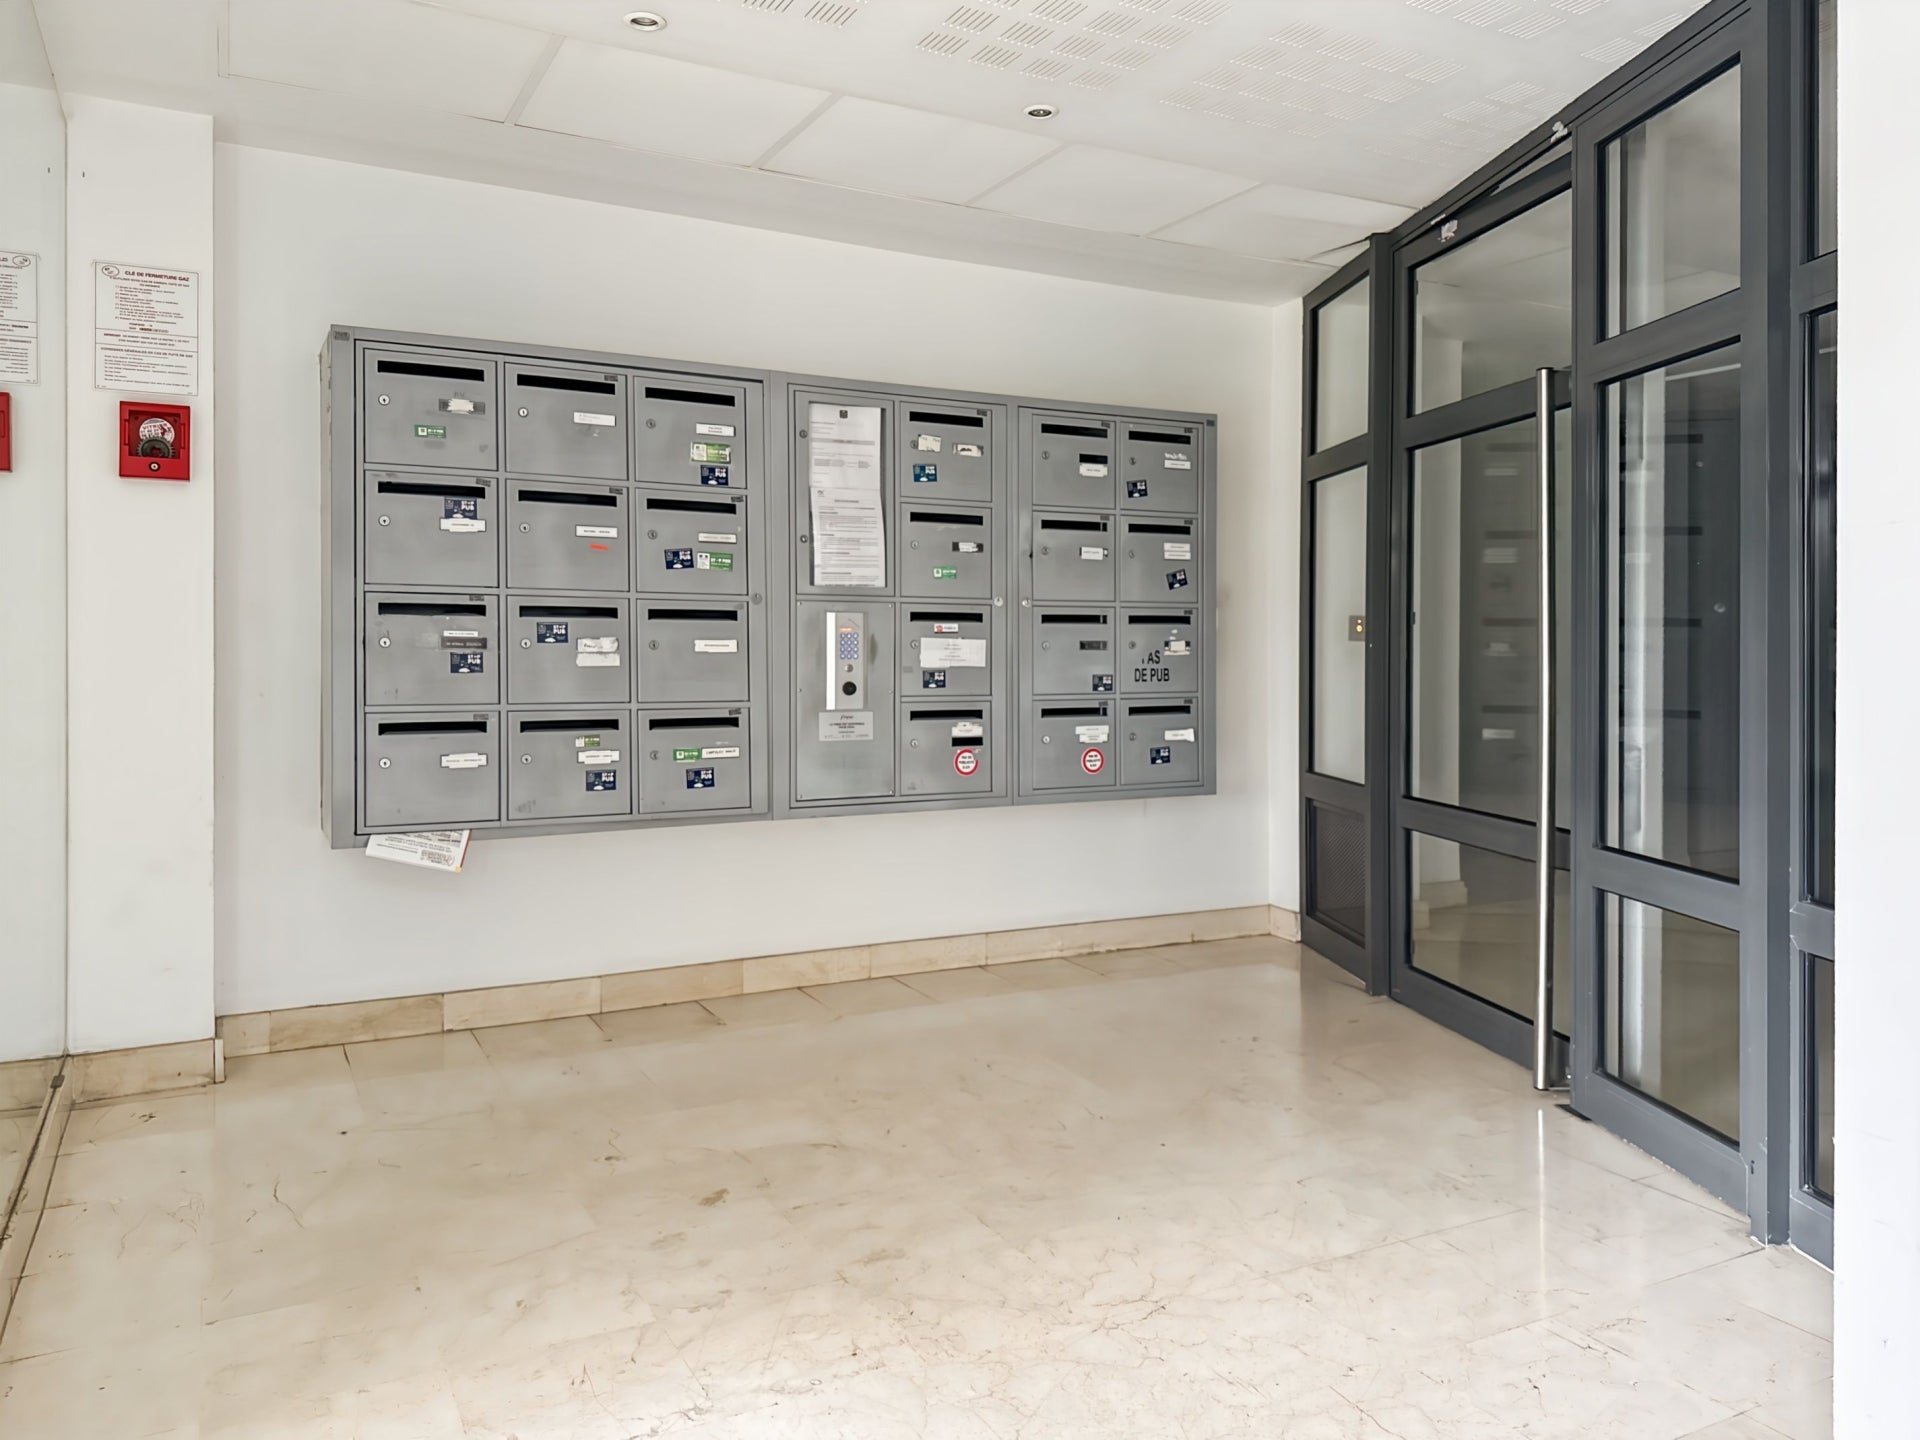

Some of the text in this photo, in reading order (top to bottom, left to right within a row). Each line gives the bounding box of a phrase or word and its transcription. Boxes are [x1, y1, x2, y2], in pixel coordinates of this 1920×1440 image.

[1142, 650, 1160, 664] AS
[1134, 668, 1170, 682] DE PUB
